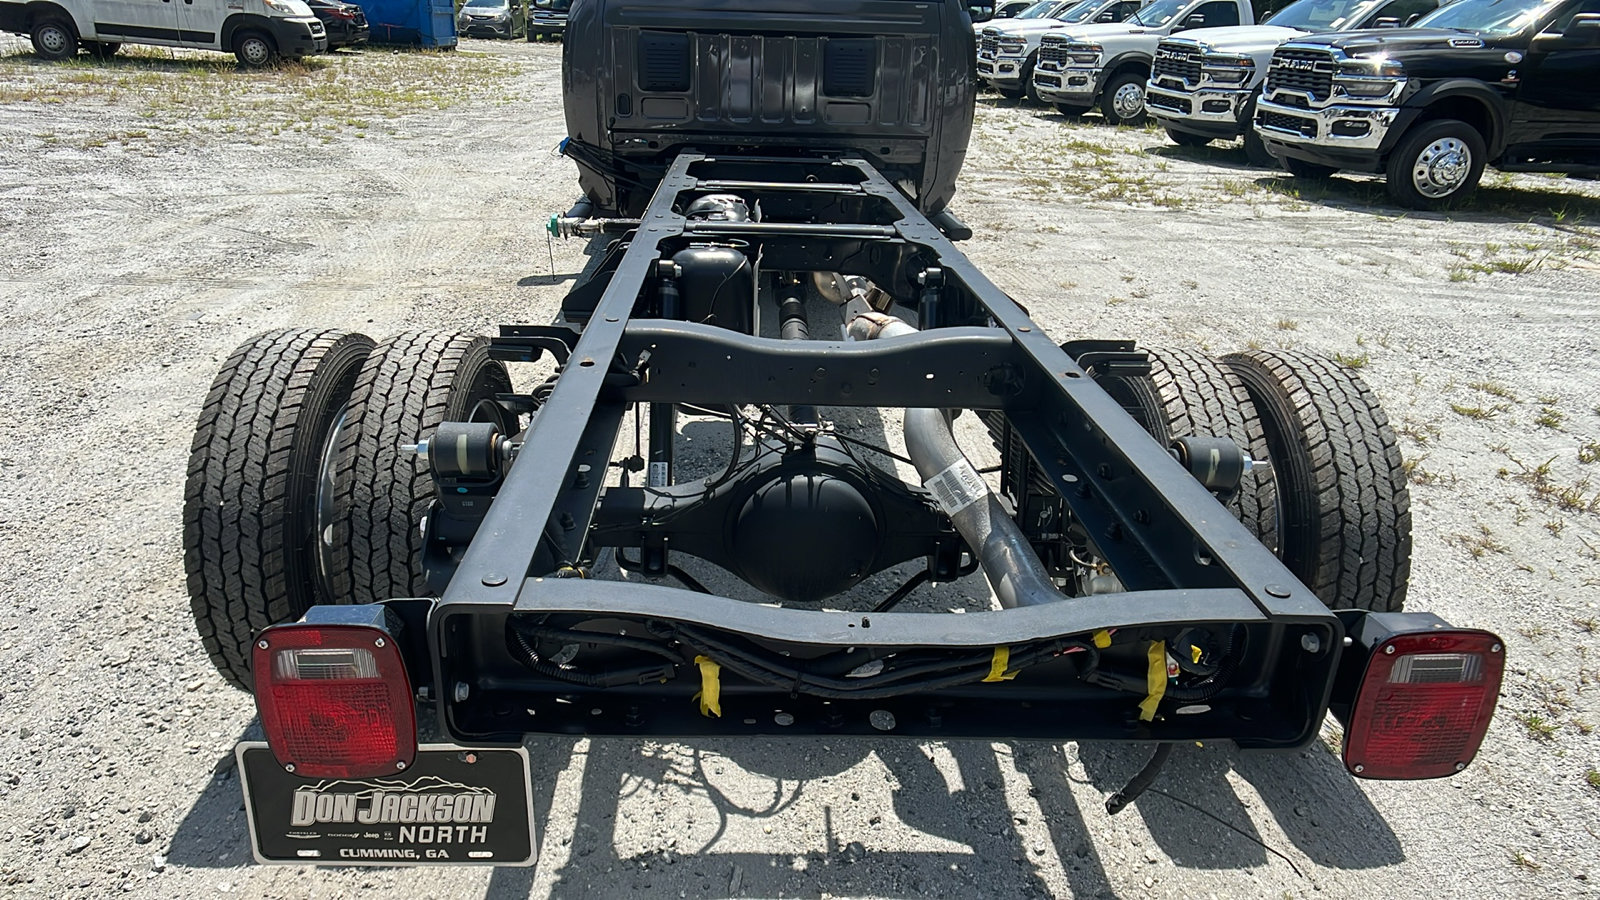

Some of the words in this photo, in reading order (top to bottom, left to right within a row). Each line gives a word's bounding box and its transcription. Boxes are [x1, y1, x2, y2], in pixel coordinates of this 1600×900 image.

[1280, 58, 1313, 70] RAM
[291, 789, 356, 826] DON
[357, 789, 496, 824] JACKSON
[398, 825, 487, 844] NORTH
[339, 848, 420, 860] CUMMING,
[425, 849, 450, 859] GA
